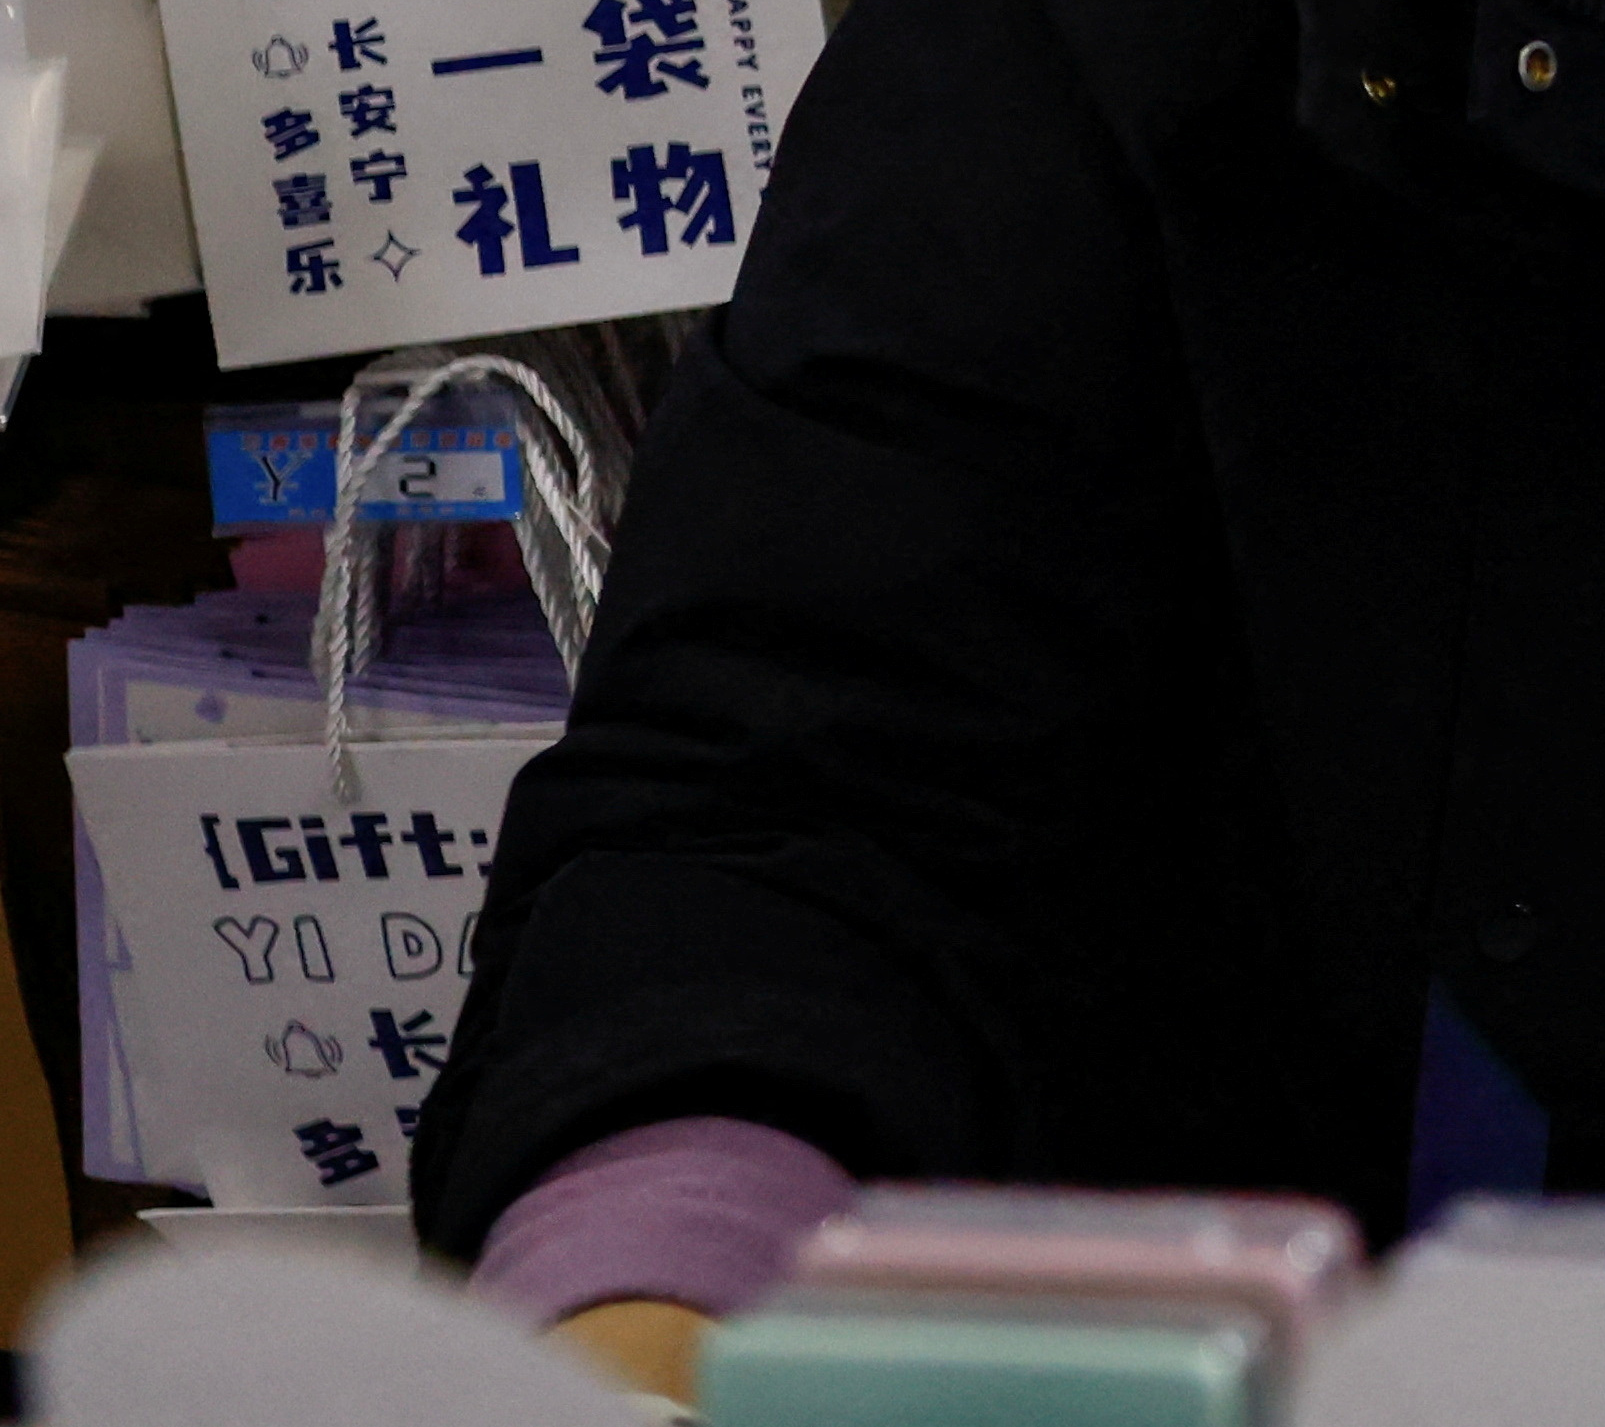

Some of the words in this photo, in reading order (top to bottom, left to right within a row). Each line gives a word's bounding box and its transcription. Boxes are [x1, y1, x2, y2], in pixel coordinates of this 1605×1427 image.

[452, 139, 737, 279] 礼物
[400, 454, 437, 501] 2
[212, 913, 337, 986] YI
